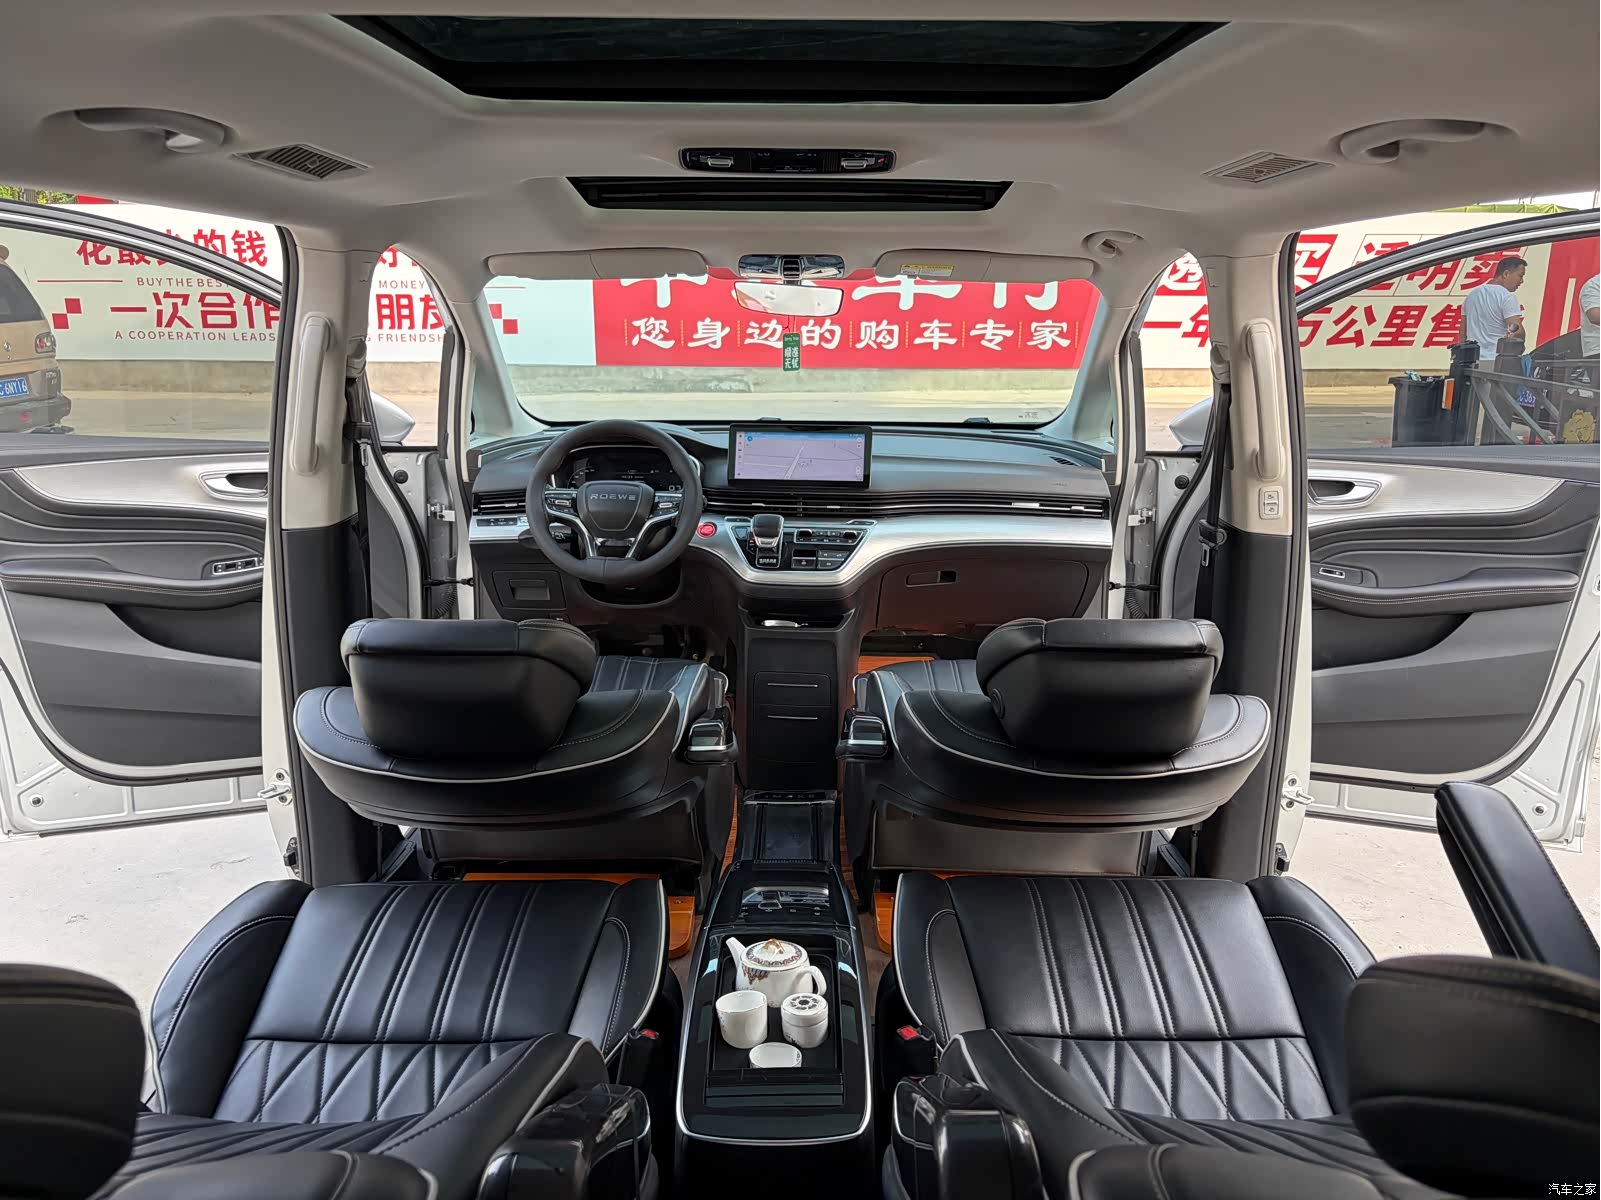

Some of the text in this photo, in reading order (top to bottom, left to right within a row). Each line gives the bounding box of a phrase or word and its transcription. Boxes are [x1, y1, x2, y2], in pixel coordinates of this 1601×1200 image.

[136, 277, 163, 287] BUY
[166, 278, 193, 287] THE
[378, 280, 425, 289] MONEY
[376, 294, 445, 330] 朋友
[1297, 304, 1525, 349] 万公里售
[114, 331, 276, 342] A COOPERATION LEADS
[631, 316, 1072, 351] 您身边的购车专家
[590, 493, 637, 501] ROEWE
